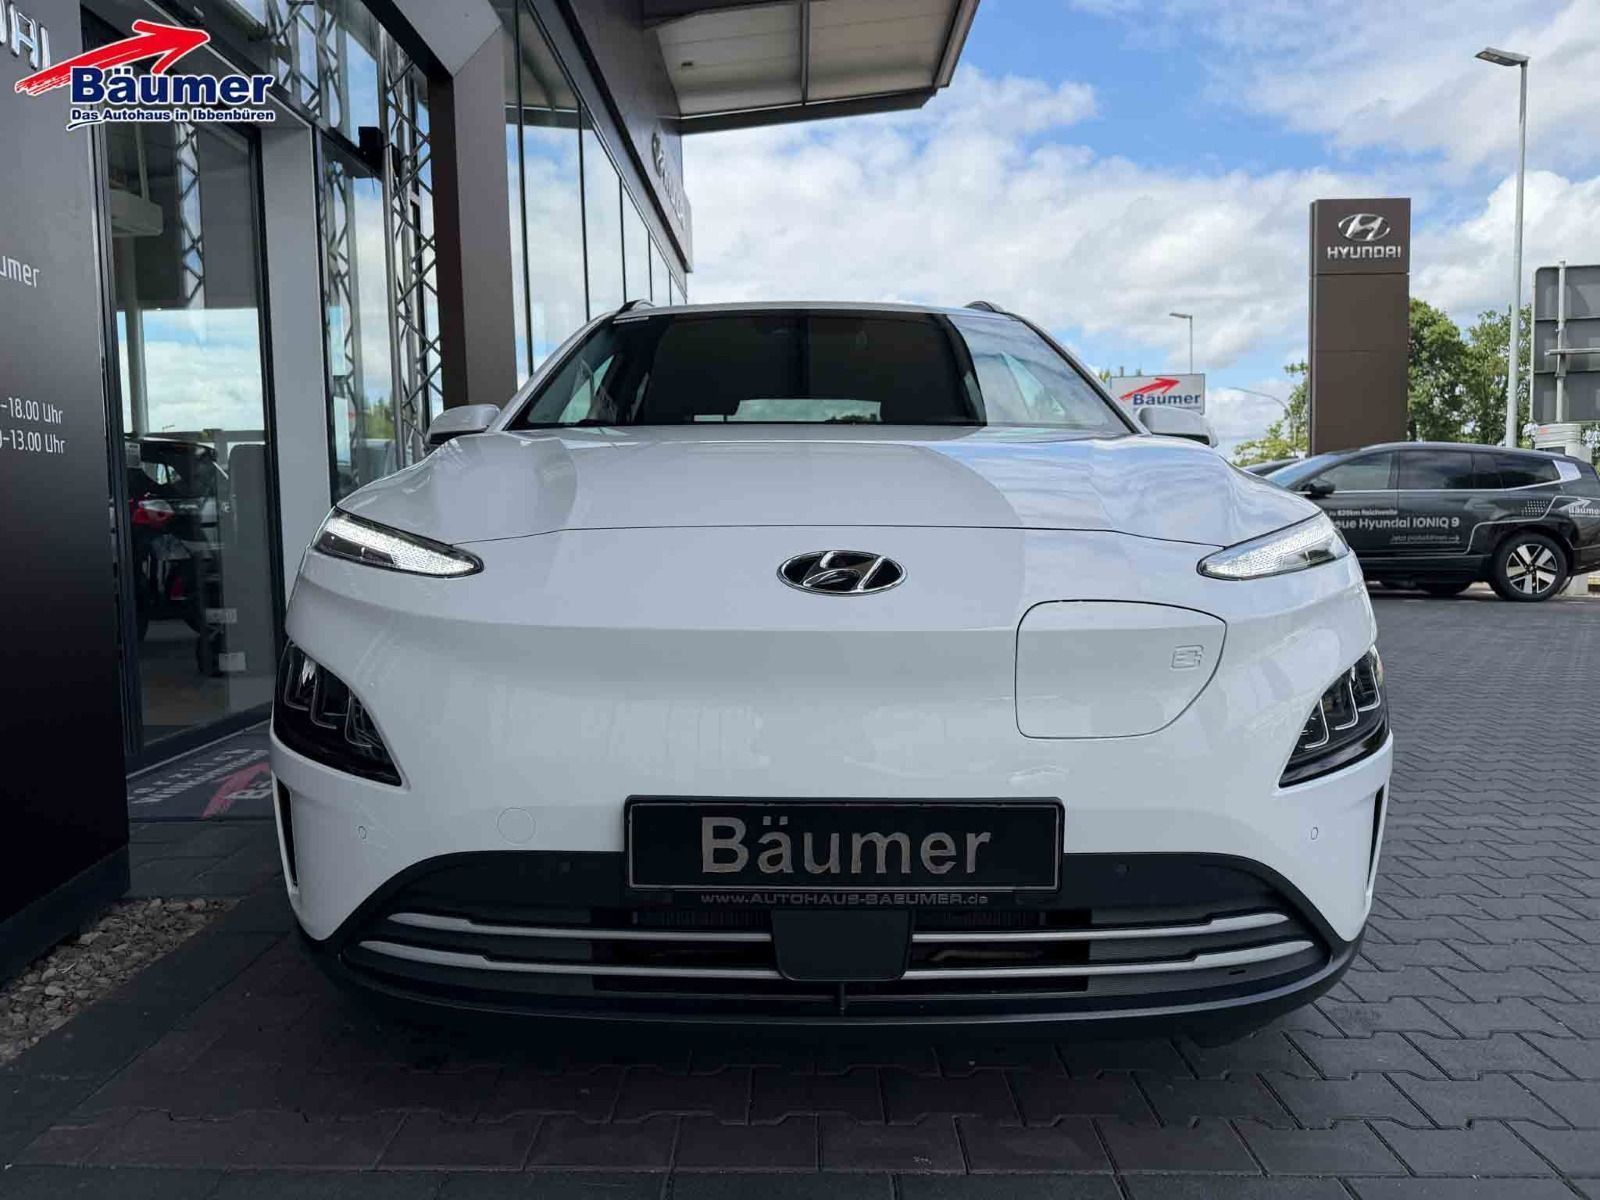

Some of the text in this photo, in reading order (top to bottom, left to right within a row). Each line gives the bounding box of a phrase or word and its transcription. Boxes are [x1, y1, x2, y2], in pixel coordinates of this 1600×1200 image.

[1327, 246, 1401, 259] HYUNDAI
[1133, 393, 1201, 406] Bäumer
[42, 402, 64, 425] Uhr
[0, 429, 67, 455] -13.00 Uhr
[1359, 517, 1410, 531] Hyundai
[1412, 516, 1449, 529] IONIQ
[1450, 516, 1460, 527] 9
[702, 815, 991, 874] Bäumer
